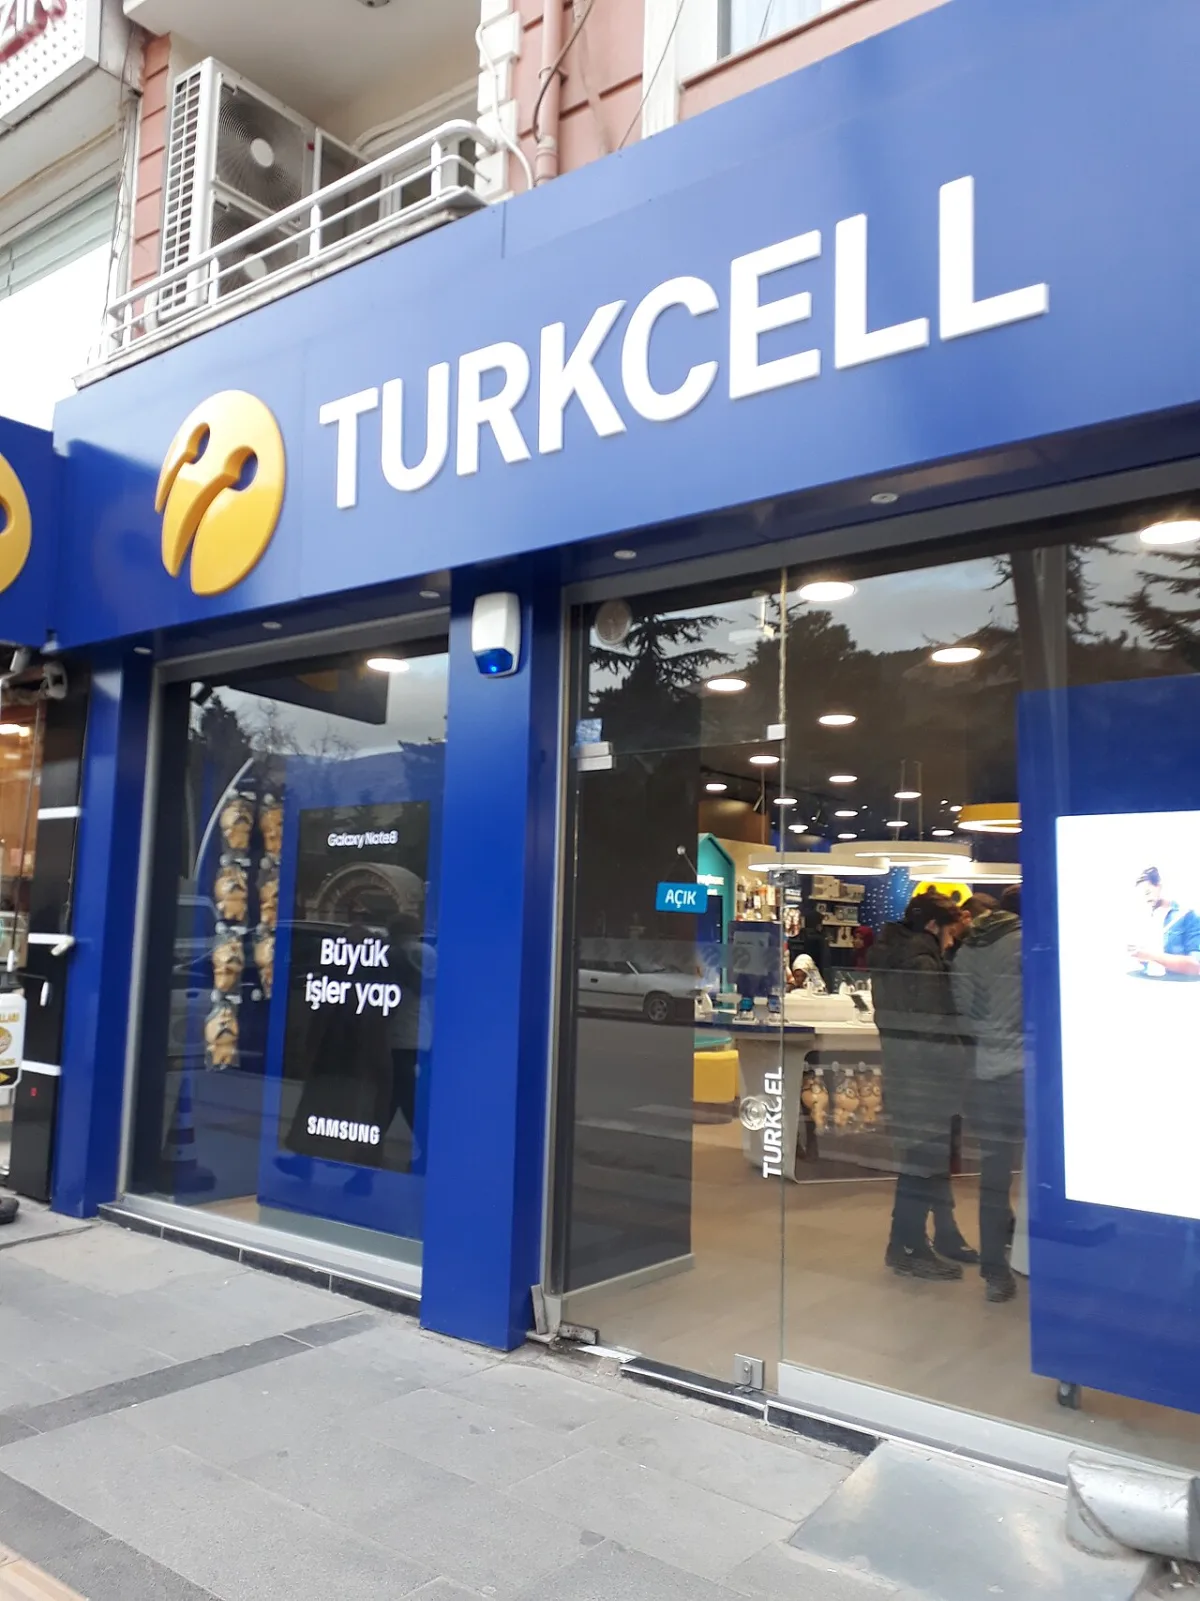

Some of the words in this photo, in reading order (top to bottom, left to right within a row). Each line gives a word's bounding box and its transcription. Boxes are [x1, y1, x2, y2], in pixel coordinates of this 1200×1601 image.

[319, 175, 1050, 509] TURKCELL
[327, 832, 365, 849] Galaxy
[365, 830, 399, 846] Note8
[664, 889, 697, 909] AÇIK
[320, 937, 390, 976] Büyük
[305, 972, 352, 1011] işler
[354, 981, 402, 1017] yap
[306, 1115, 381, 1145] SAMSUNG
